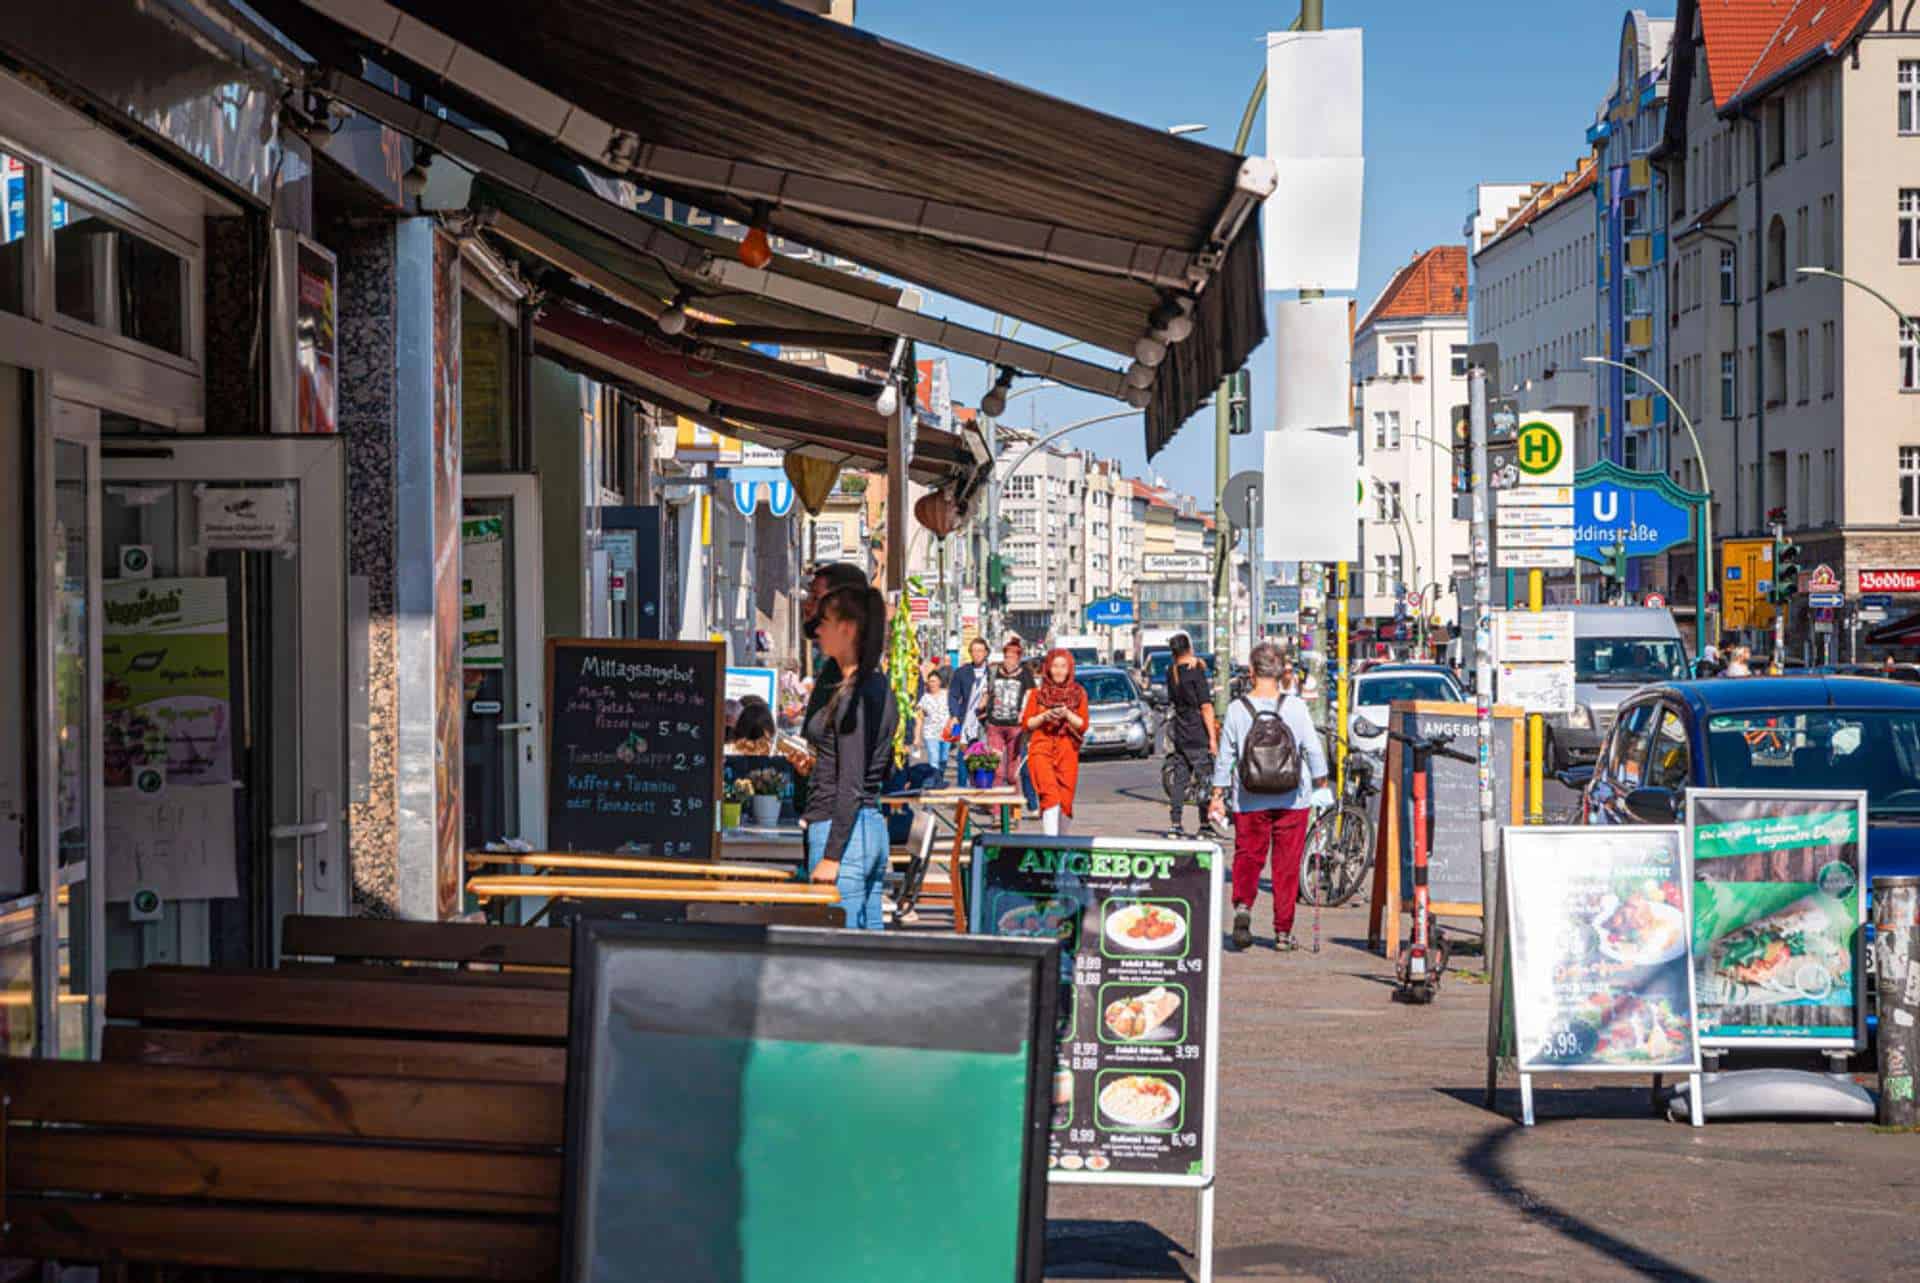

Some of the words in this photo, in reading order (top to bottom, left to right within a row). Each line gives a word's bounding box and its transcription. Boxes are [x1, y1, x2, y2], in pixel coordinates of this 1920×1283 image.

[1525, 434, 1549, 462] H
[1593, 491, 1618, 522] U
[1109, 602, 1121, 614] U
[581, 656, 695, 686] Mittagsangebot
[1424, 722, 1479, 738] ANGEBO
[1018, 849, 1176, 879] ANGEBOT
